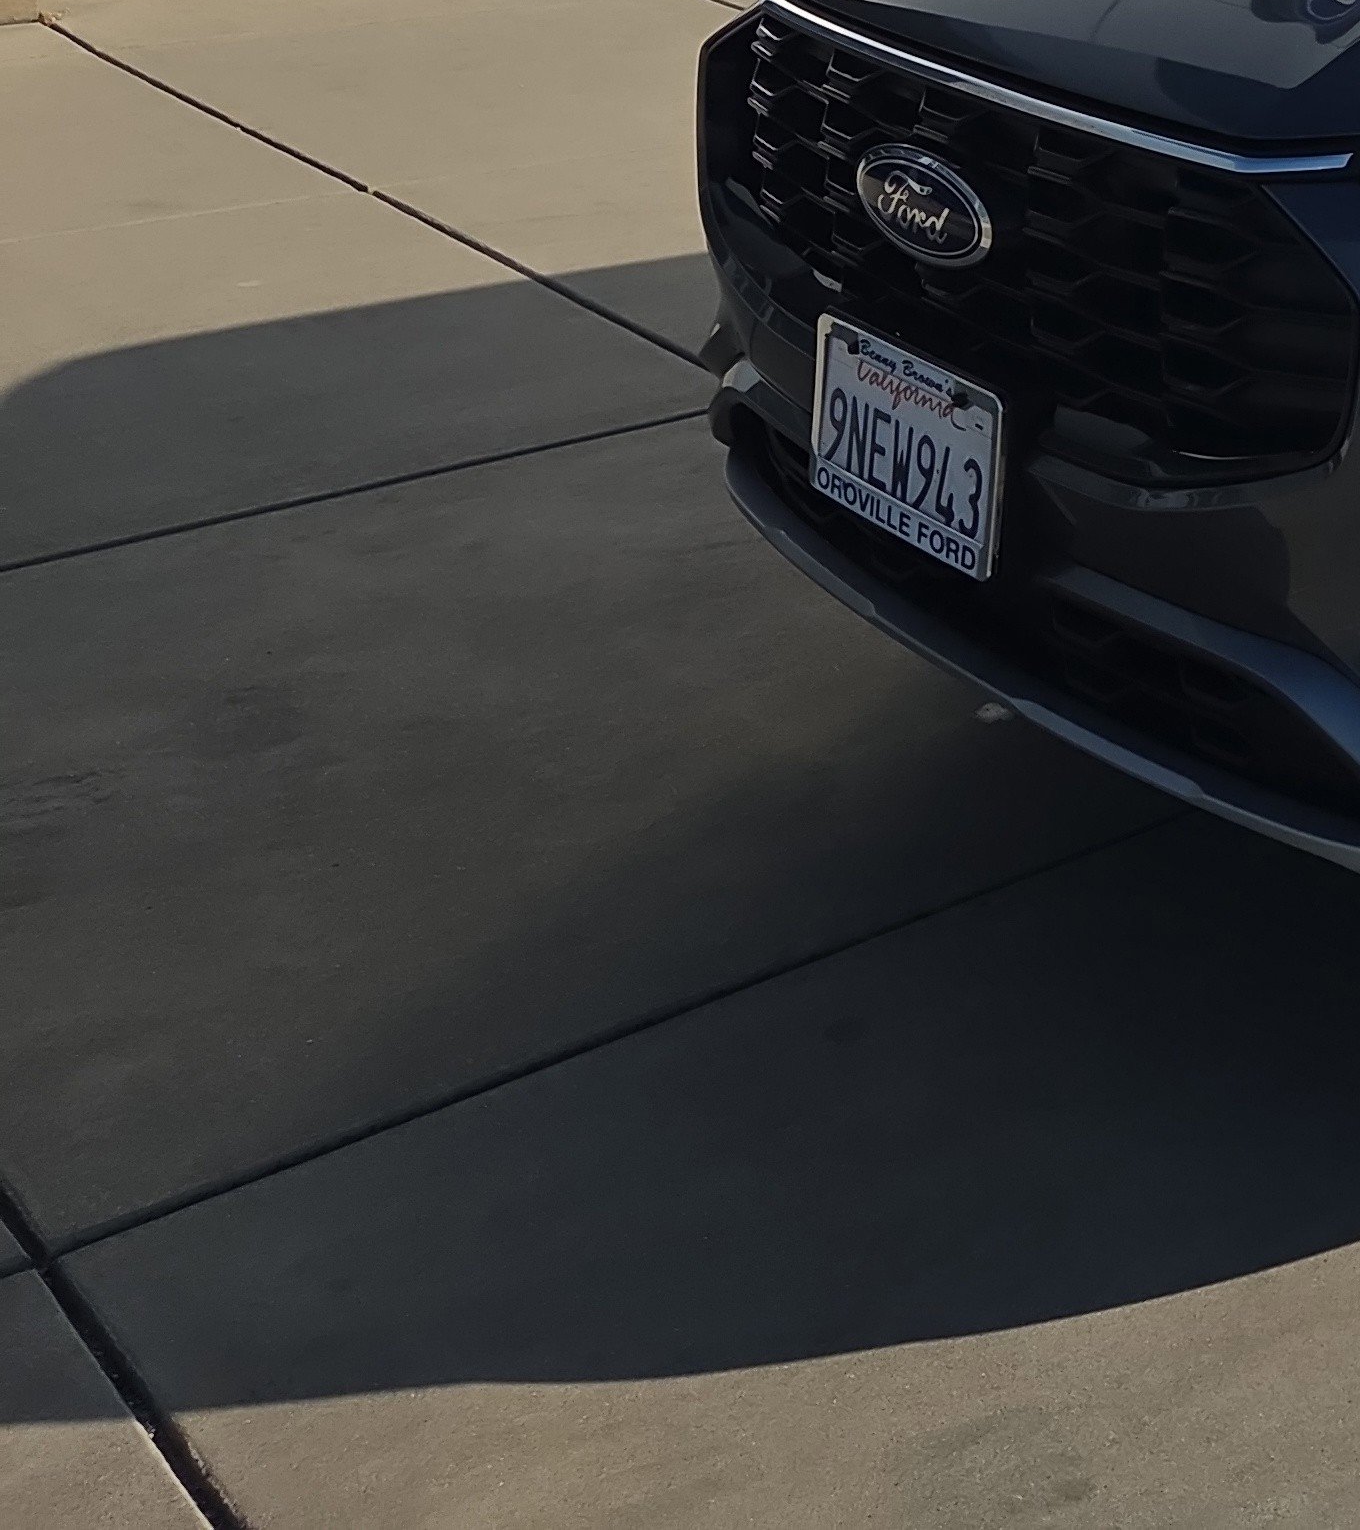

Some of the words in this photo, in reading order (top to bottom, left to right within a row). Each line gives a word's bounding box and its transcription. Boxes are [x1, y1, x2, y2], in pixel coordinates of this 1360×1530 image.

[877, 170, 950, 244] Ford
[857, 362, 958, 418] California
[858, 338, 897, 373] Benny
[901, 359, 954, 397] Brown's
[822, 387, 983, 540] 9NEW943
[816, 466, 911, 536] OROVILLE
[917, 521, 976, 571] FORD
